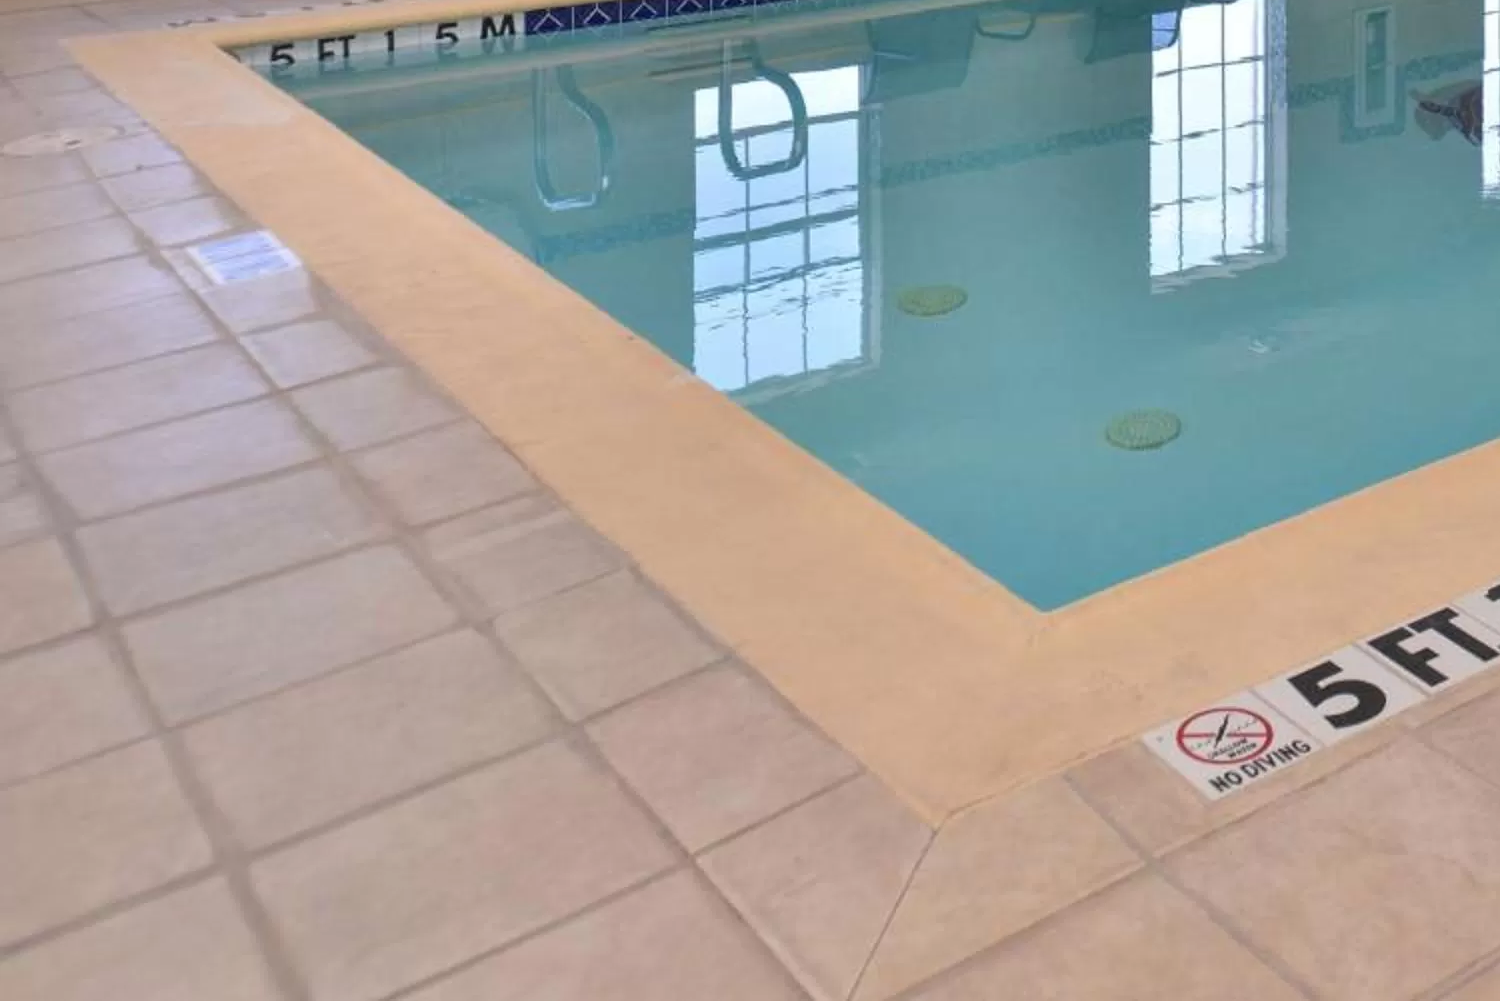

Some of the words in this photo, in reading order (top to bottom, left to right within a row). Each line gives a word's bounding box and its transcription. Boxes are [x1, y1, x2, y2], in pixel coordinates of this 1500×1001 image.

[270, 43, 295, 65] 5
[317, 35, 356, 61] FT
[384, 29, 395, 51] 1
[436, 22, 459, 43] 5
[480, 14, 516, 40] M
[1287, 660, 1388, 730] 5
[1208, 769, 1244, 793] NO
[1240, 739, 1312, 779] DIVING
